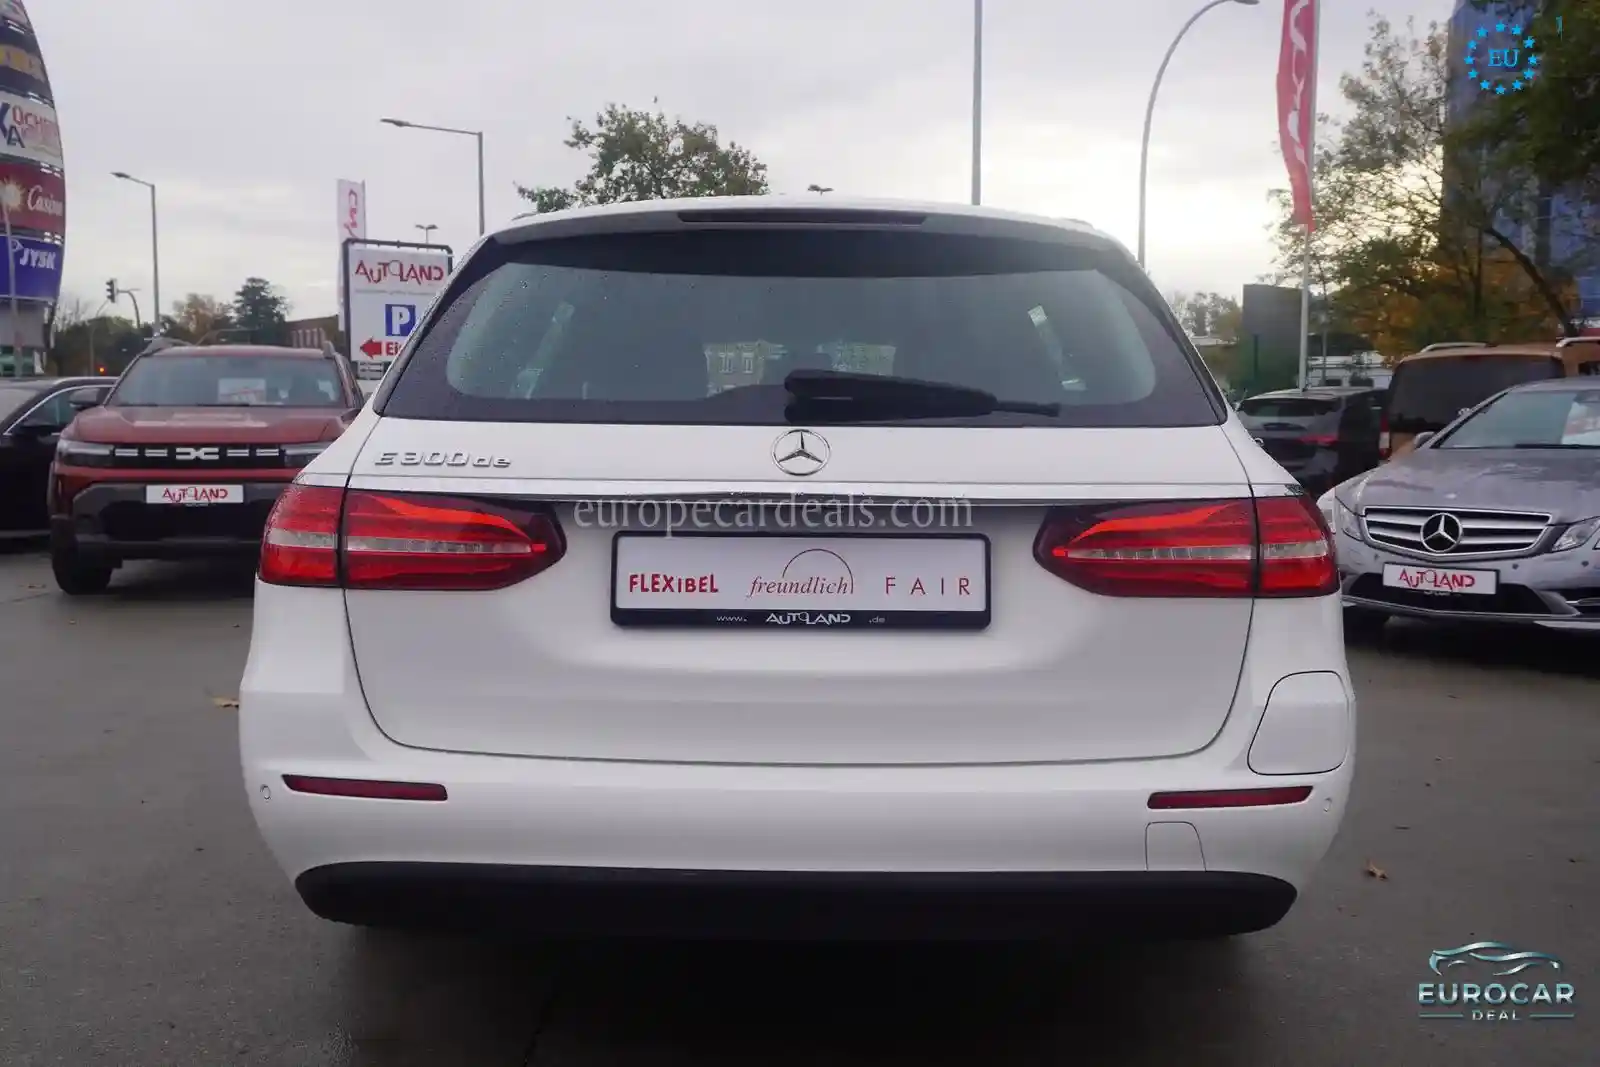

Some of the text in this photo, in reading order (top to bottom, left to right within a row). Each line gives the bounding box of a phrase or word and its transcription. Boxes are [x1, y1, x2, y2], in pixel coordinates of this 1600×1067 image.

[19, 247, 57, 269] JYSK
[747, 574, 848, 600] freundlich
[884, 576, 971, 596] FAIR
[716, 614, 748, 622] www.
